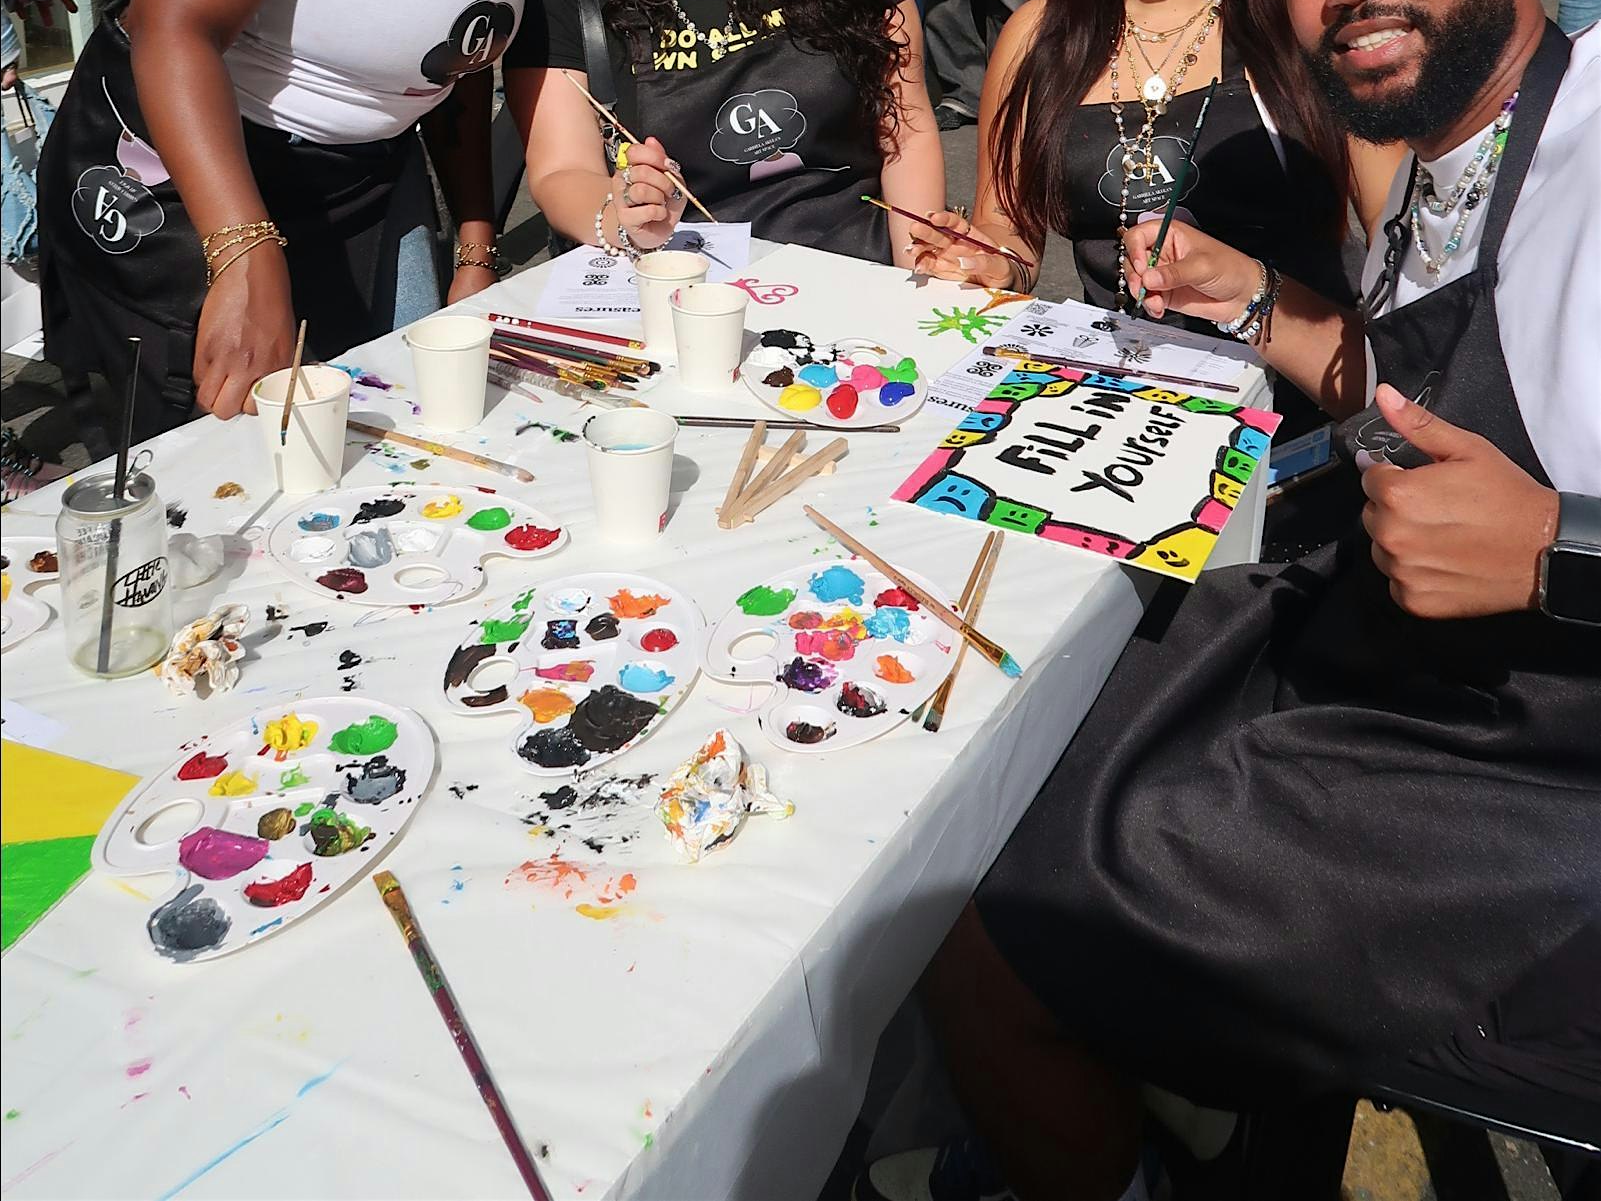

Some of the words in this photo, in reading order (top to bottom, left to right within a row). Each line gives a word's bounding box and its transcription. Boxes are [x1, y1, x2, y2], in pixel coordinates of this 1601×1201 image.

[461, 14, 495, 65] GA
[660, 28, 697, 49] DO
[729, 102, 783, 139] GA
[1121, 147, 1175, 187] GA
[95, 186, 127, 242] GA
